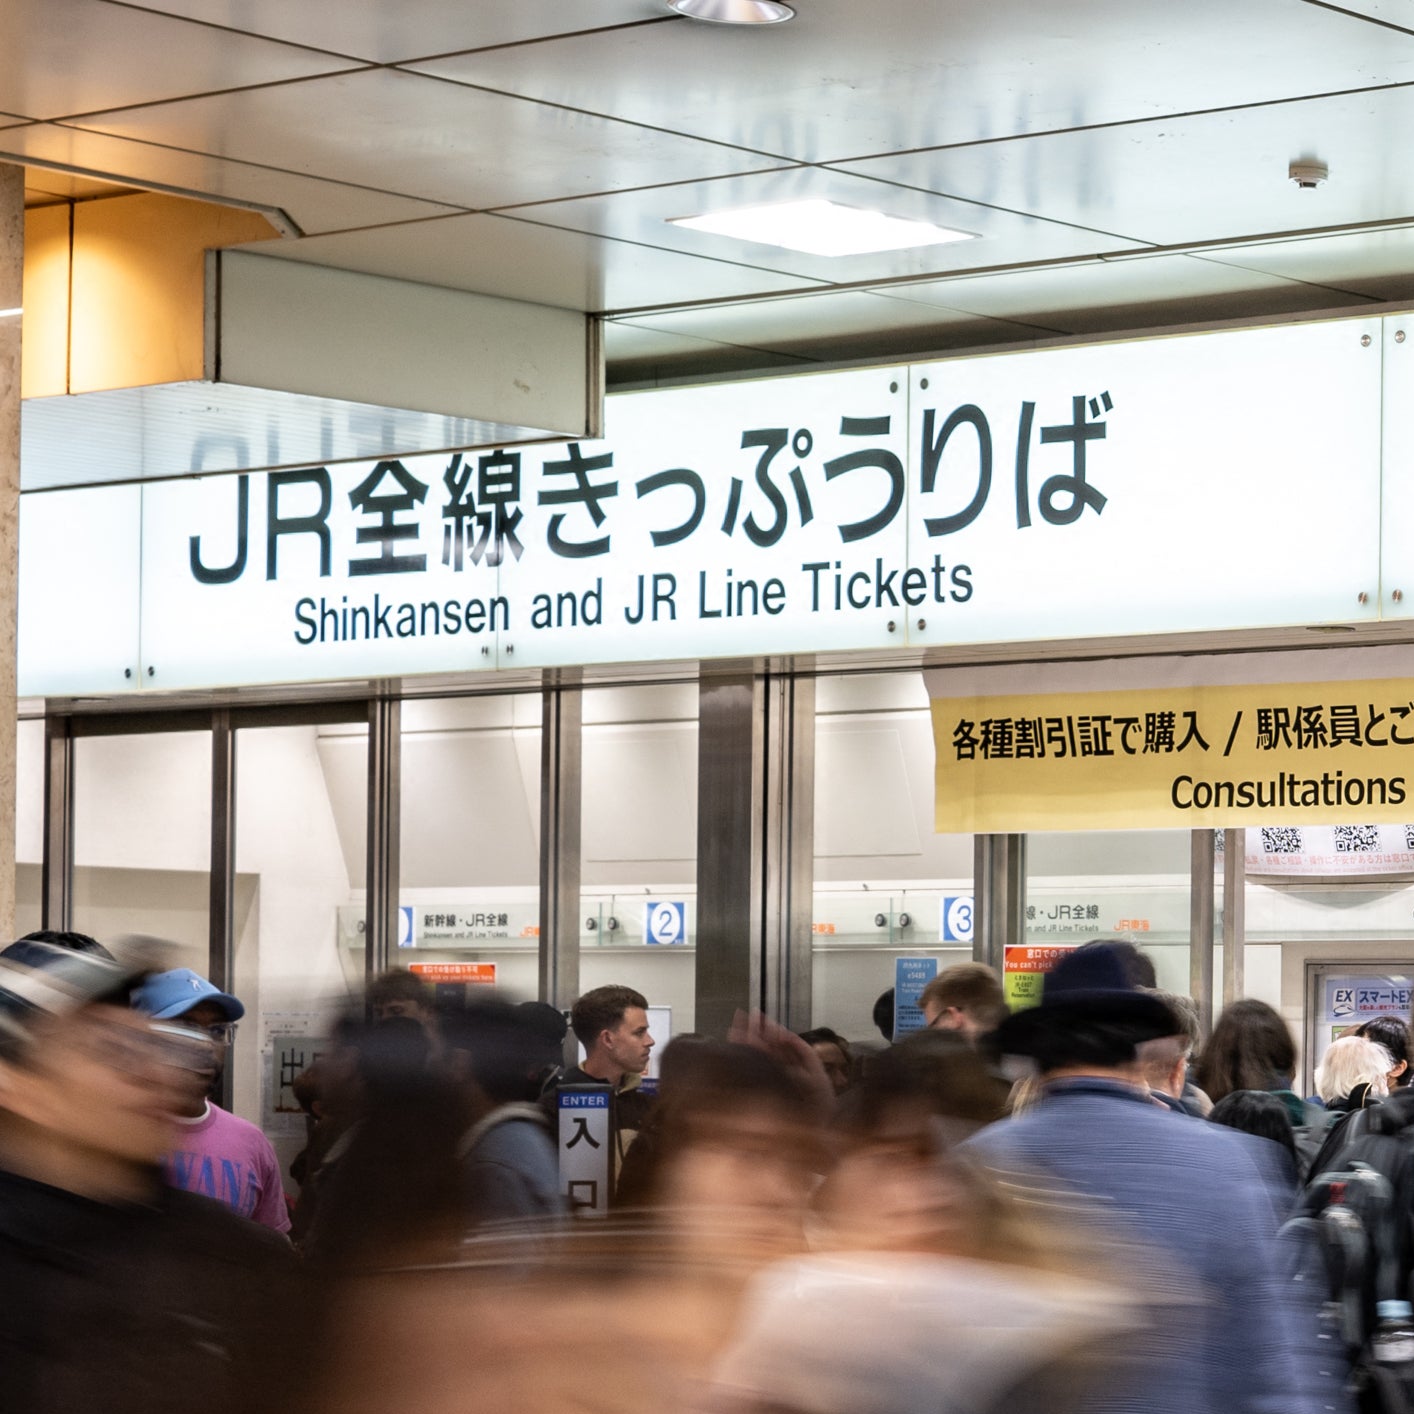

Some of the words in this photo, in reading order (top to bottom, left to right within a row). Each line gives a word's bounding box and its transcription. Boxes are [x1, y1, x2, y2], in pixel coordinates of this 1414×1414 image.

[189, 390, 1114, 585] JR全線きっぷうりば
[294, 594, 509, 645] Shinkansen
[531, 578, 602, 629] and
[624, 572, 677, 625] JR
[699, 568, 786, 619] Line
[801, 554, 973, 612] Tickets
[952, 711, 1210, 760] 各種割引証で購入
[1171, 770, 1406, 809] Consultations
[659, 910, 672, 936] 2
[956, 905, 972, 932] 3
[1335, 990, 1354, 1002] EX
[562, 1096, 605, 1106] ENTER
[565, 1117, 601, 1210] 入口
